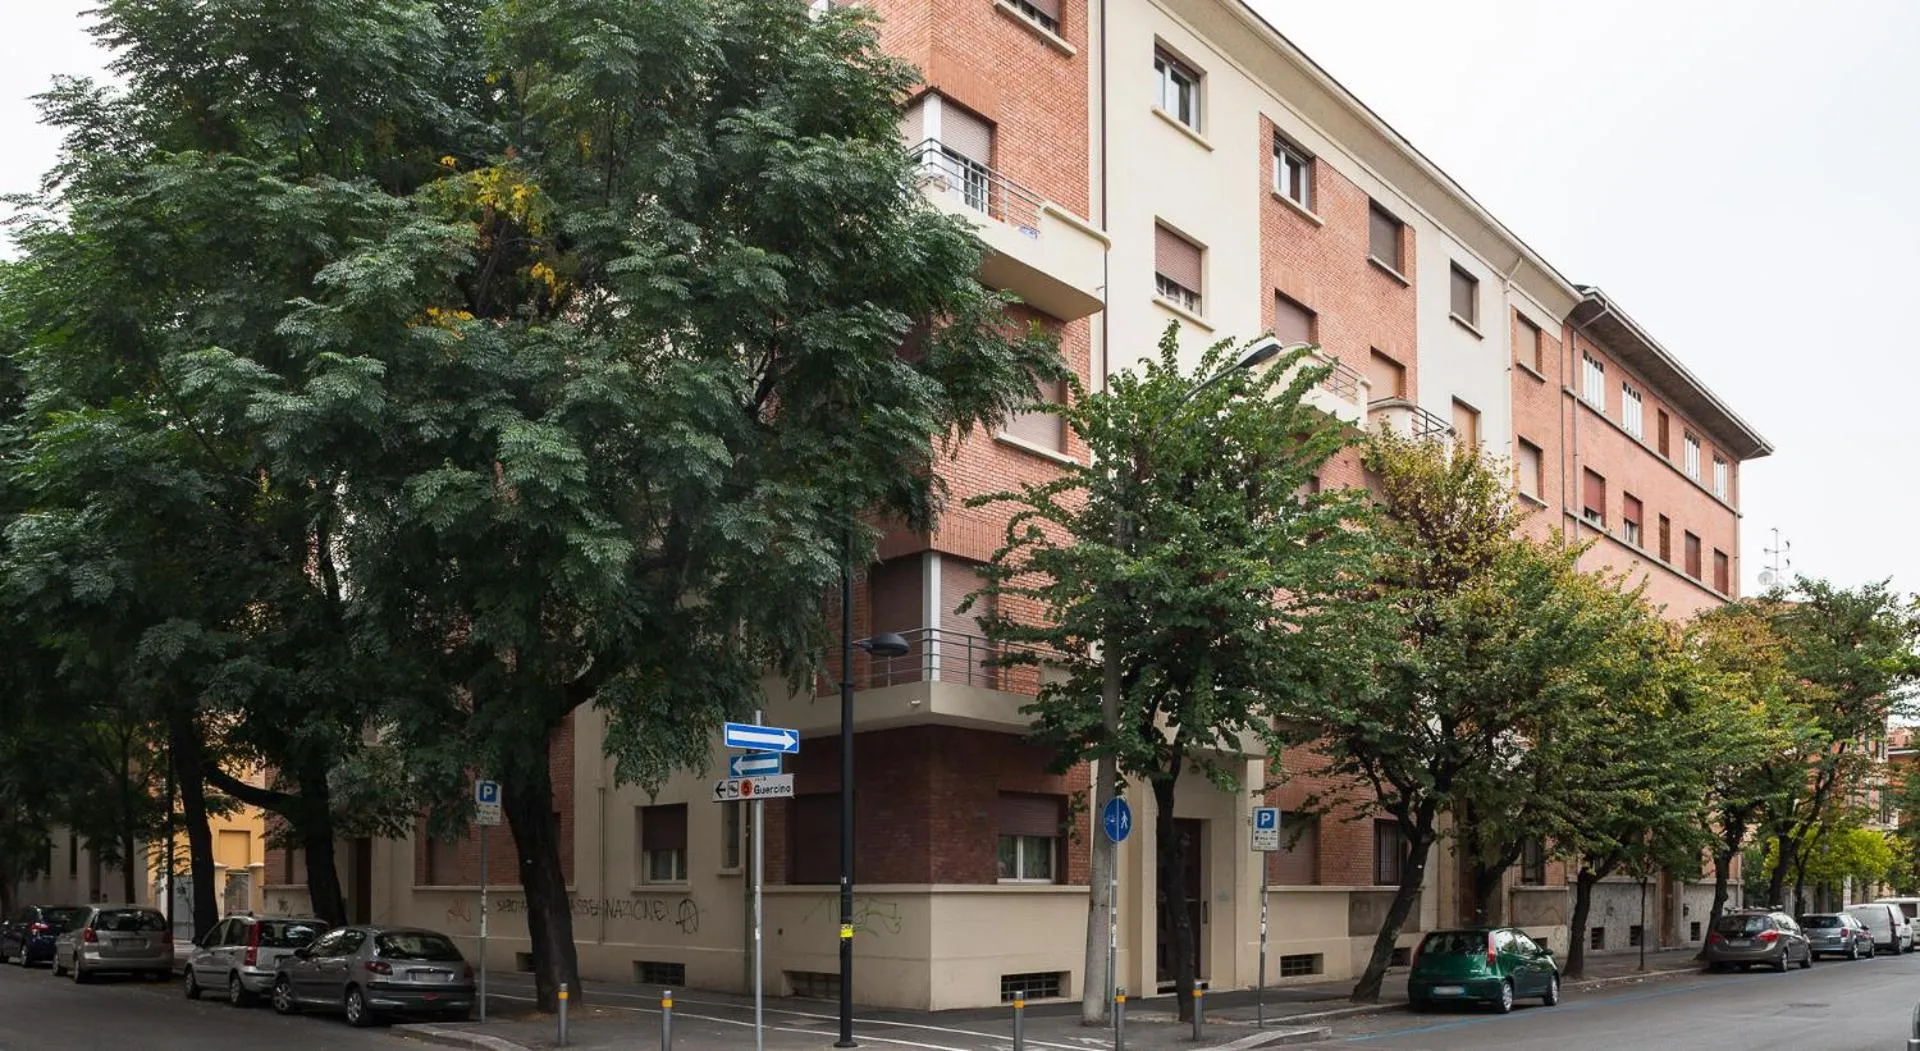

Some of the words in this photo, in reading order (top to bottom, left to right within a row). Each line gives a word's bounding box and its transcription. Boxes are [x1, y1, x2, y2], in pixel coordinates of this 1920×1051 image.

[483, 785, 493, 801] P
[754, 783, 792, 795] Guercino
[1260, 812, 1271, 827] P
